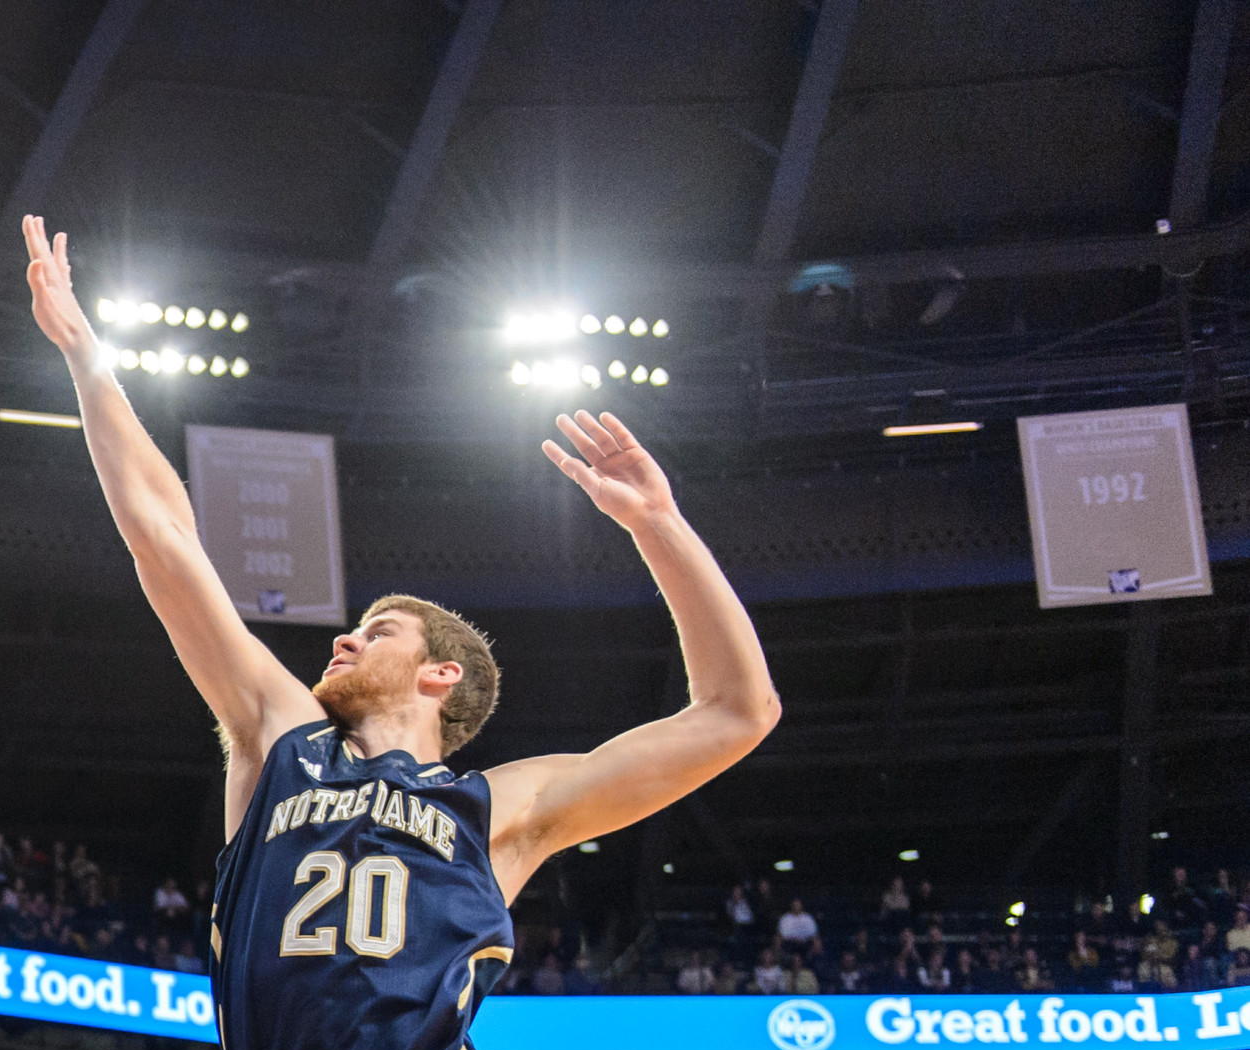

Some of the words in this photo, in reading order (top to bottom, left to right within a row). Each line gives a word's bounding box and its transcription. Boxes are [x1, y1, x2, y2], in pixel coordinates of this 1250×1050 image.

[1078, 471, 1148, 506] 1992
[265, 781, 376, 843] NOTRE
[280, 850, 410, 960] 20
[21, 955, 141, 1016] food.
[865, 996, 1028, 1044] Great
[1037, 996, 1180, 1042] food.
